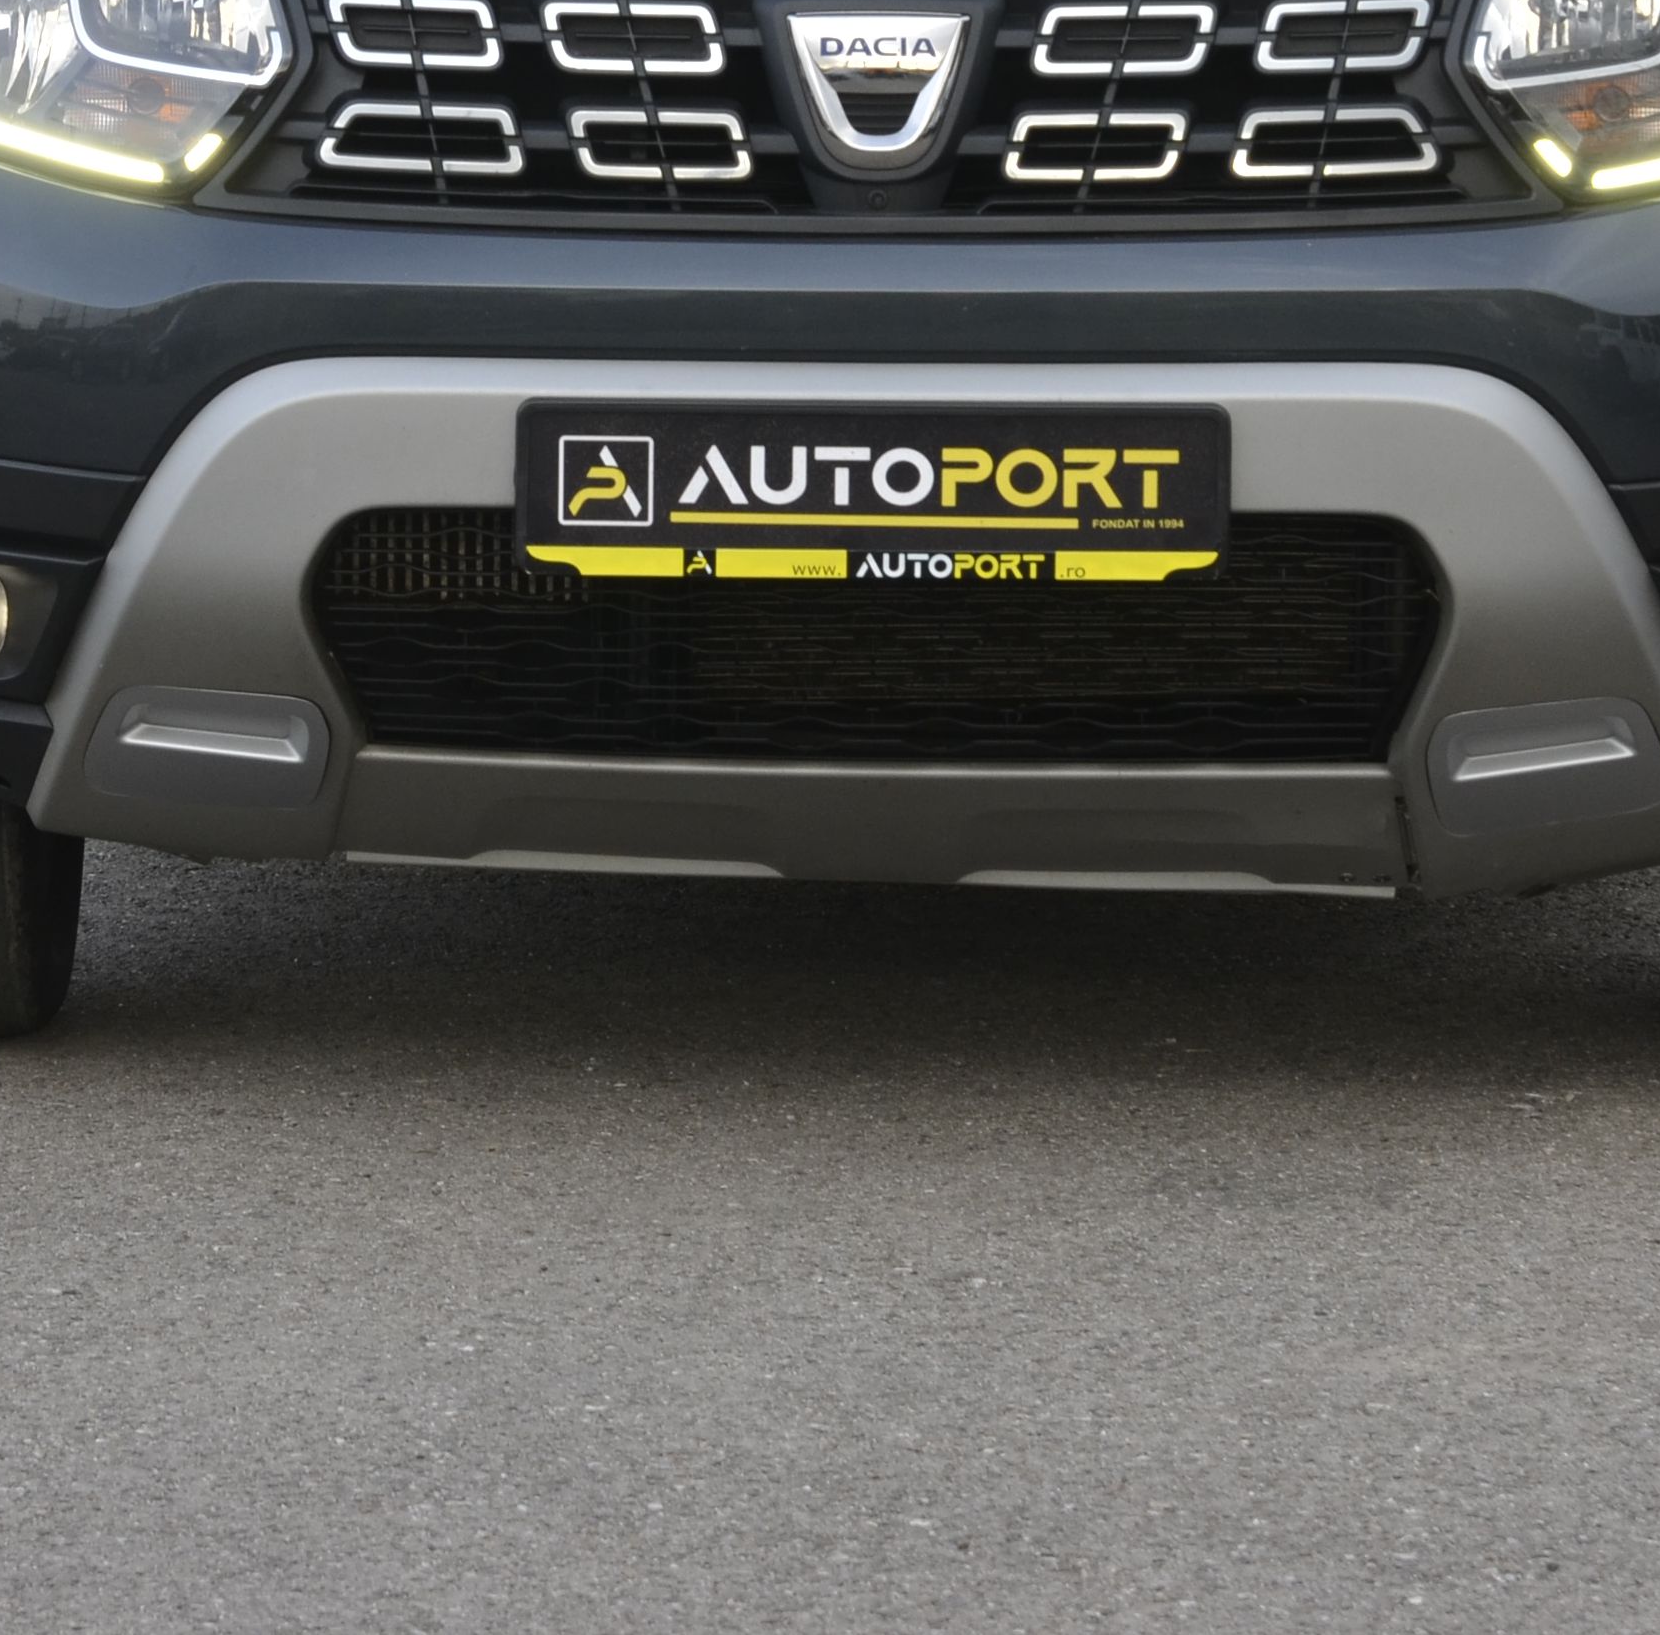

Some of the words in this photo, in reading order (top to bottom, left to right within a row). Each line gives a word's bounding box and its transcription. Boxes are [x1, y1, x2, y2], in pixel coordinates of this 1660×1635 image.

[819, 36, 937, 57] DACIA
[678, 444, 1180, 509] AUTOPORT
[1091, 518, 1141, 529] FONDAT
[1142, 518, 1156, 529] IN
[1159, 518, 1185, 529] 1994
[855, 553, 1046, 579] AUTOPORT
